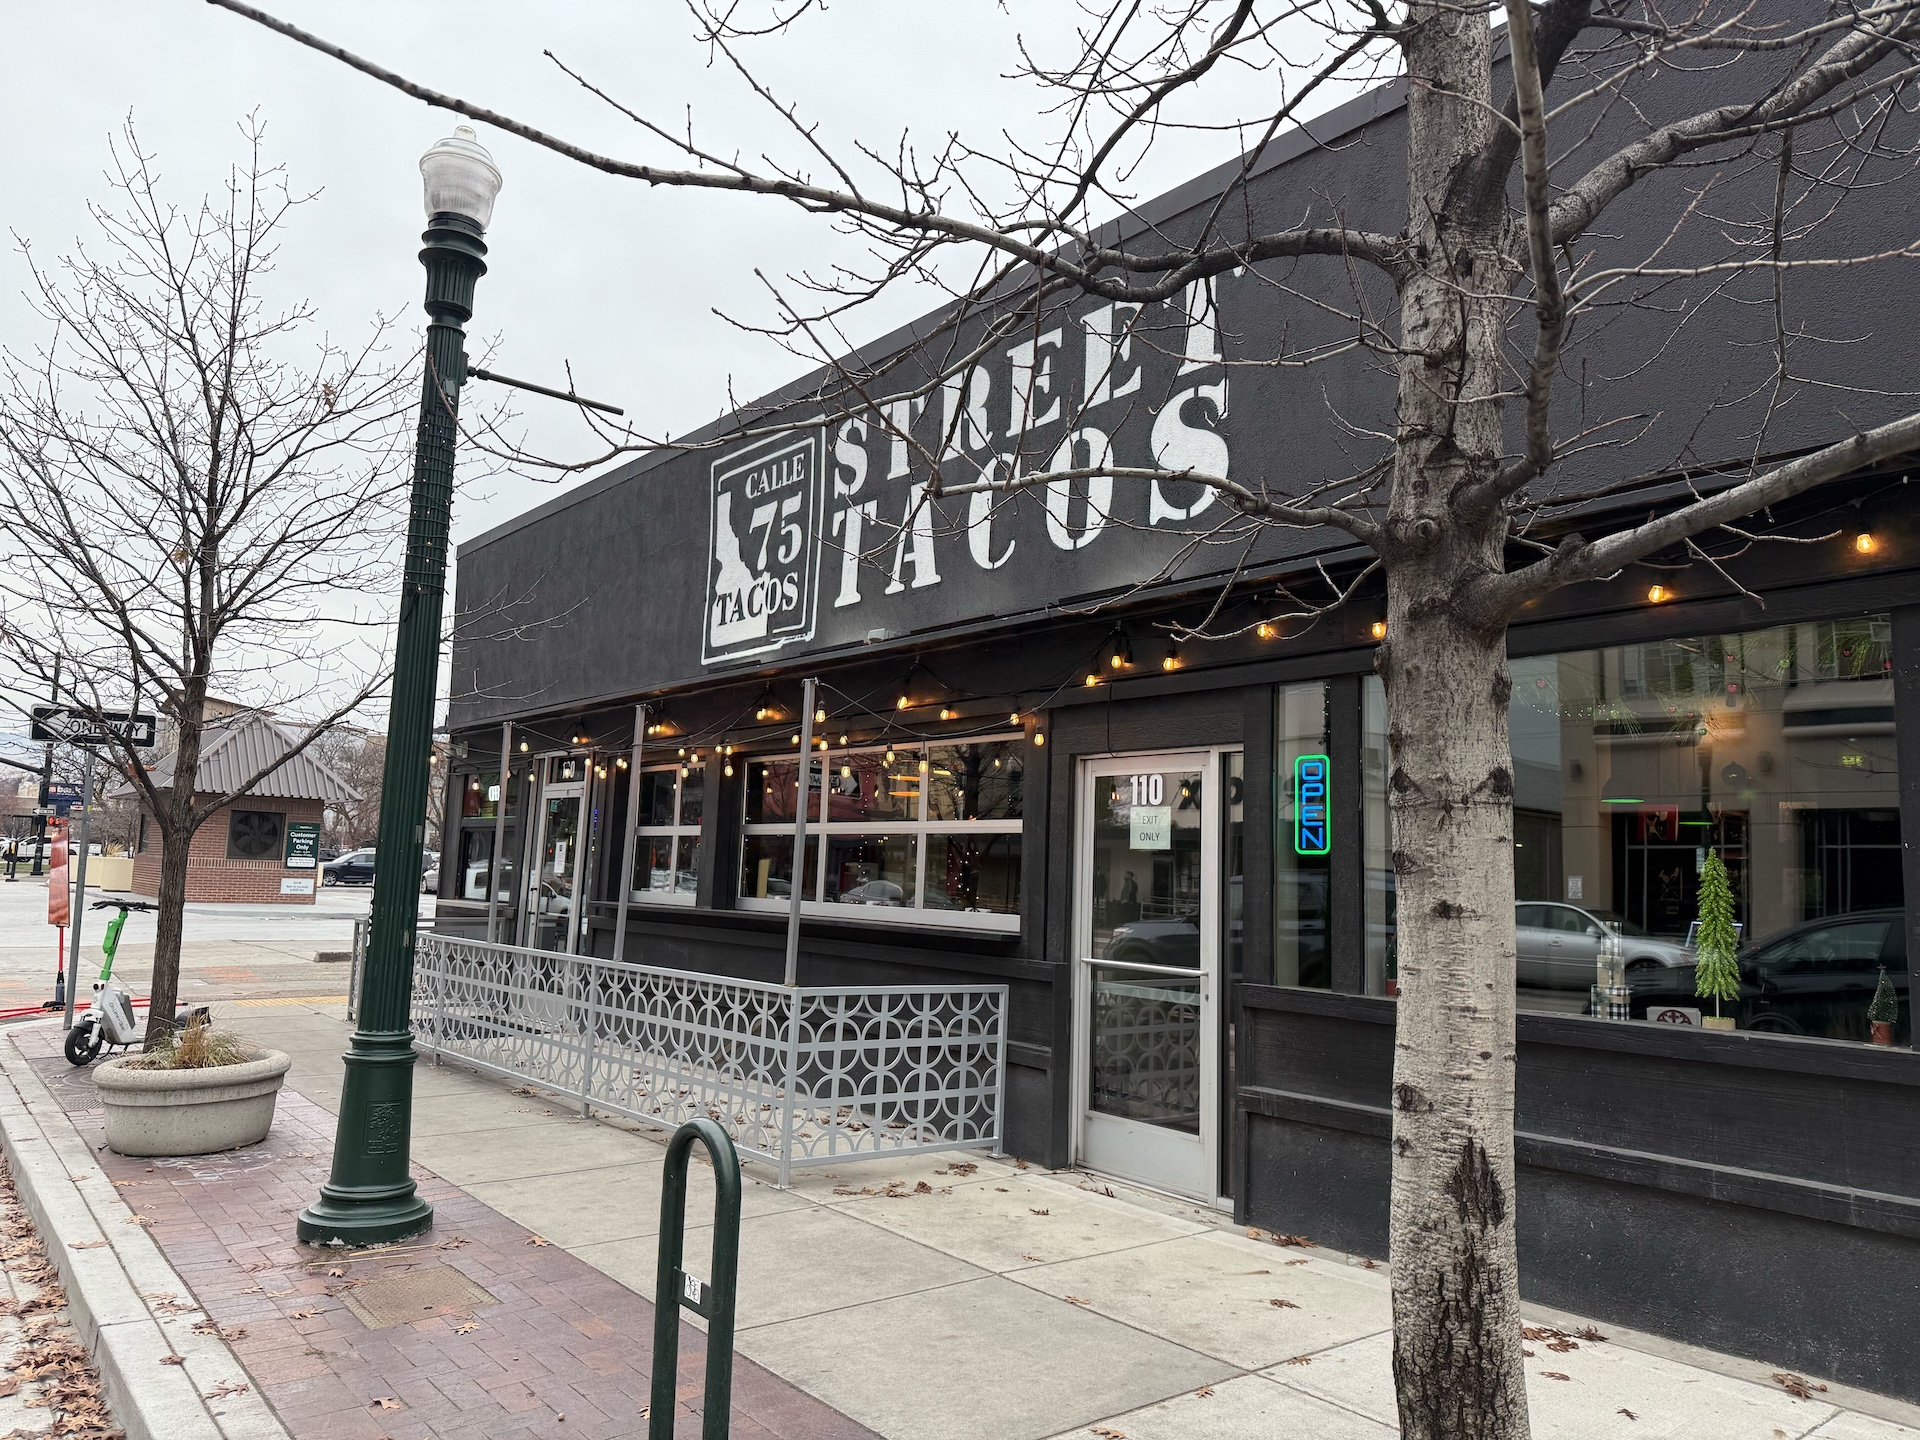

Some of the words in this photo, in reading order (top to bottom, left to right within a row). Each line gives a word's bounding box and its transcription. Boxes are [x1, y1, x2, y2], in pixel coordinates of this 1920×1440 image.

[833, 262, 1243, 500] STREET
[745, 453, 805, 499] CALLE
[832, 378, 1229, 608] TACOS
[749, 491, 802, 571] 75
[716, 571, 799, 628] TACOS
[69, 719, 101, 734] ONE
[1130, 773, 1164, 806] 110
[1301, 761, 1324, 850] OPEN
[1139, 831, 1161, 842] ONLY
[1142, 815, 1159, 825] EXIT
